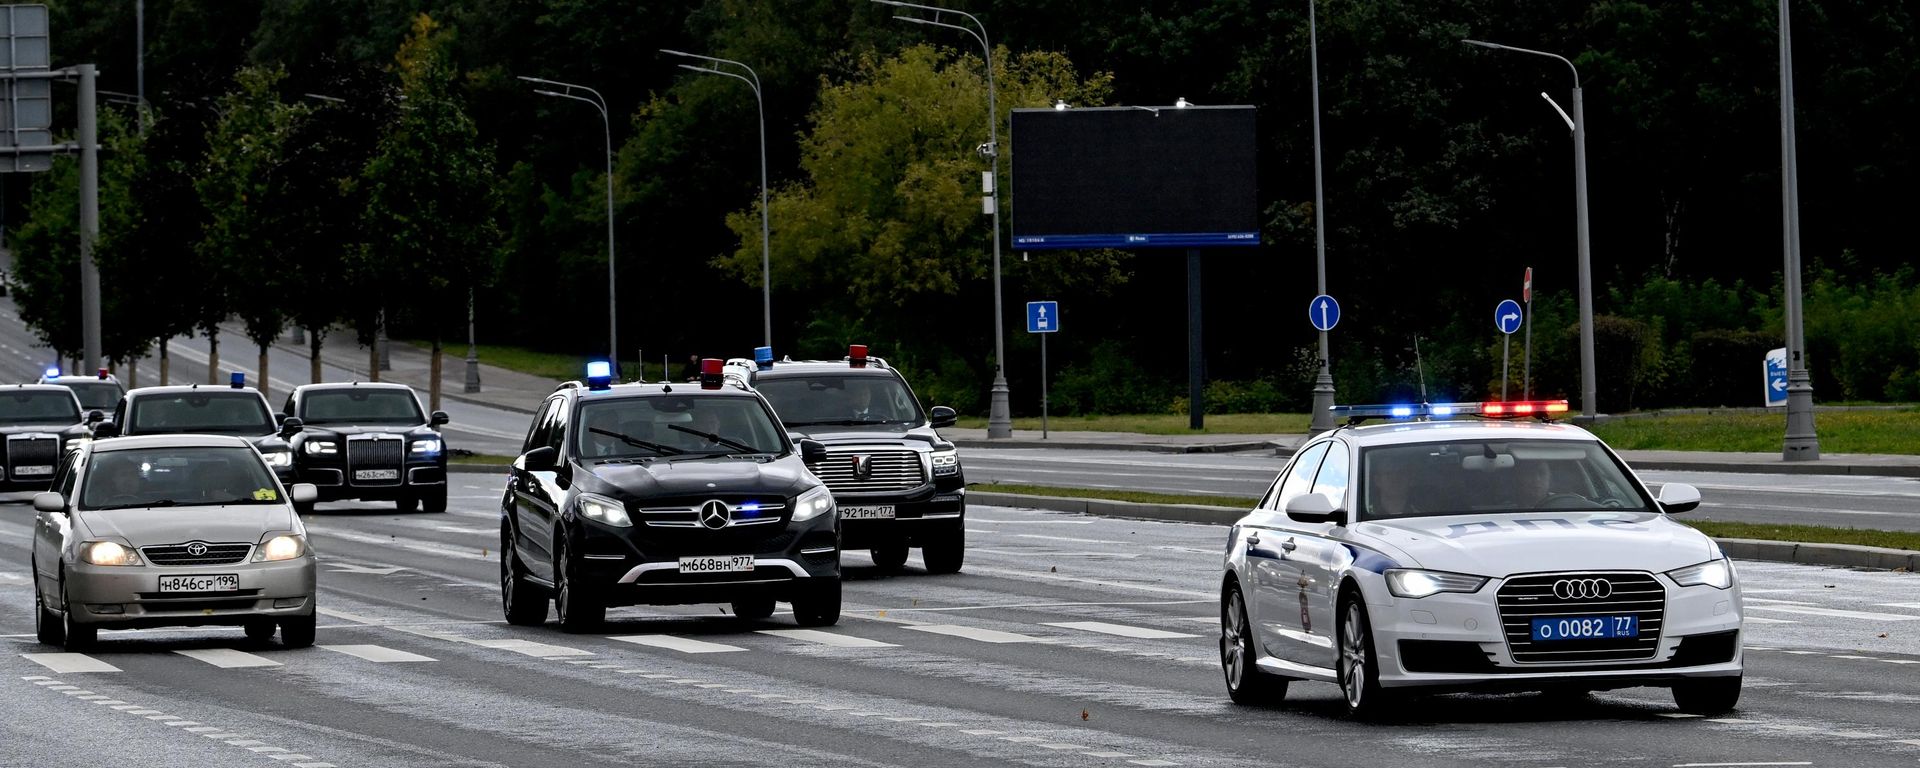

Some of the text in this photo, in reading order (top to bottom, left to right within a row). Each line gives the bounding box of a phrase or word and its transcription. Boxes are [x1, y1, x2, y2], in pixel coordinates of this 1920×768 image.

[878, 506, 893, 515] 177
[1445, 518, 1650, 539] ДПС
[682, 556, 751, 571] М668ВН 977
[164, 575, 235, 591] Н846СР 199
[1559, 619, 1604, 637] 0082
[1614, 616, 1632, 631] 77
